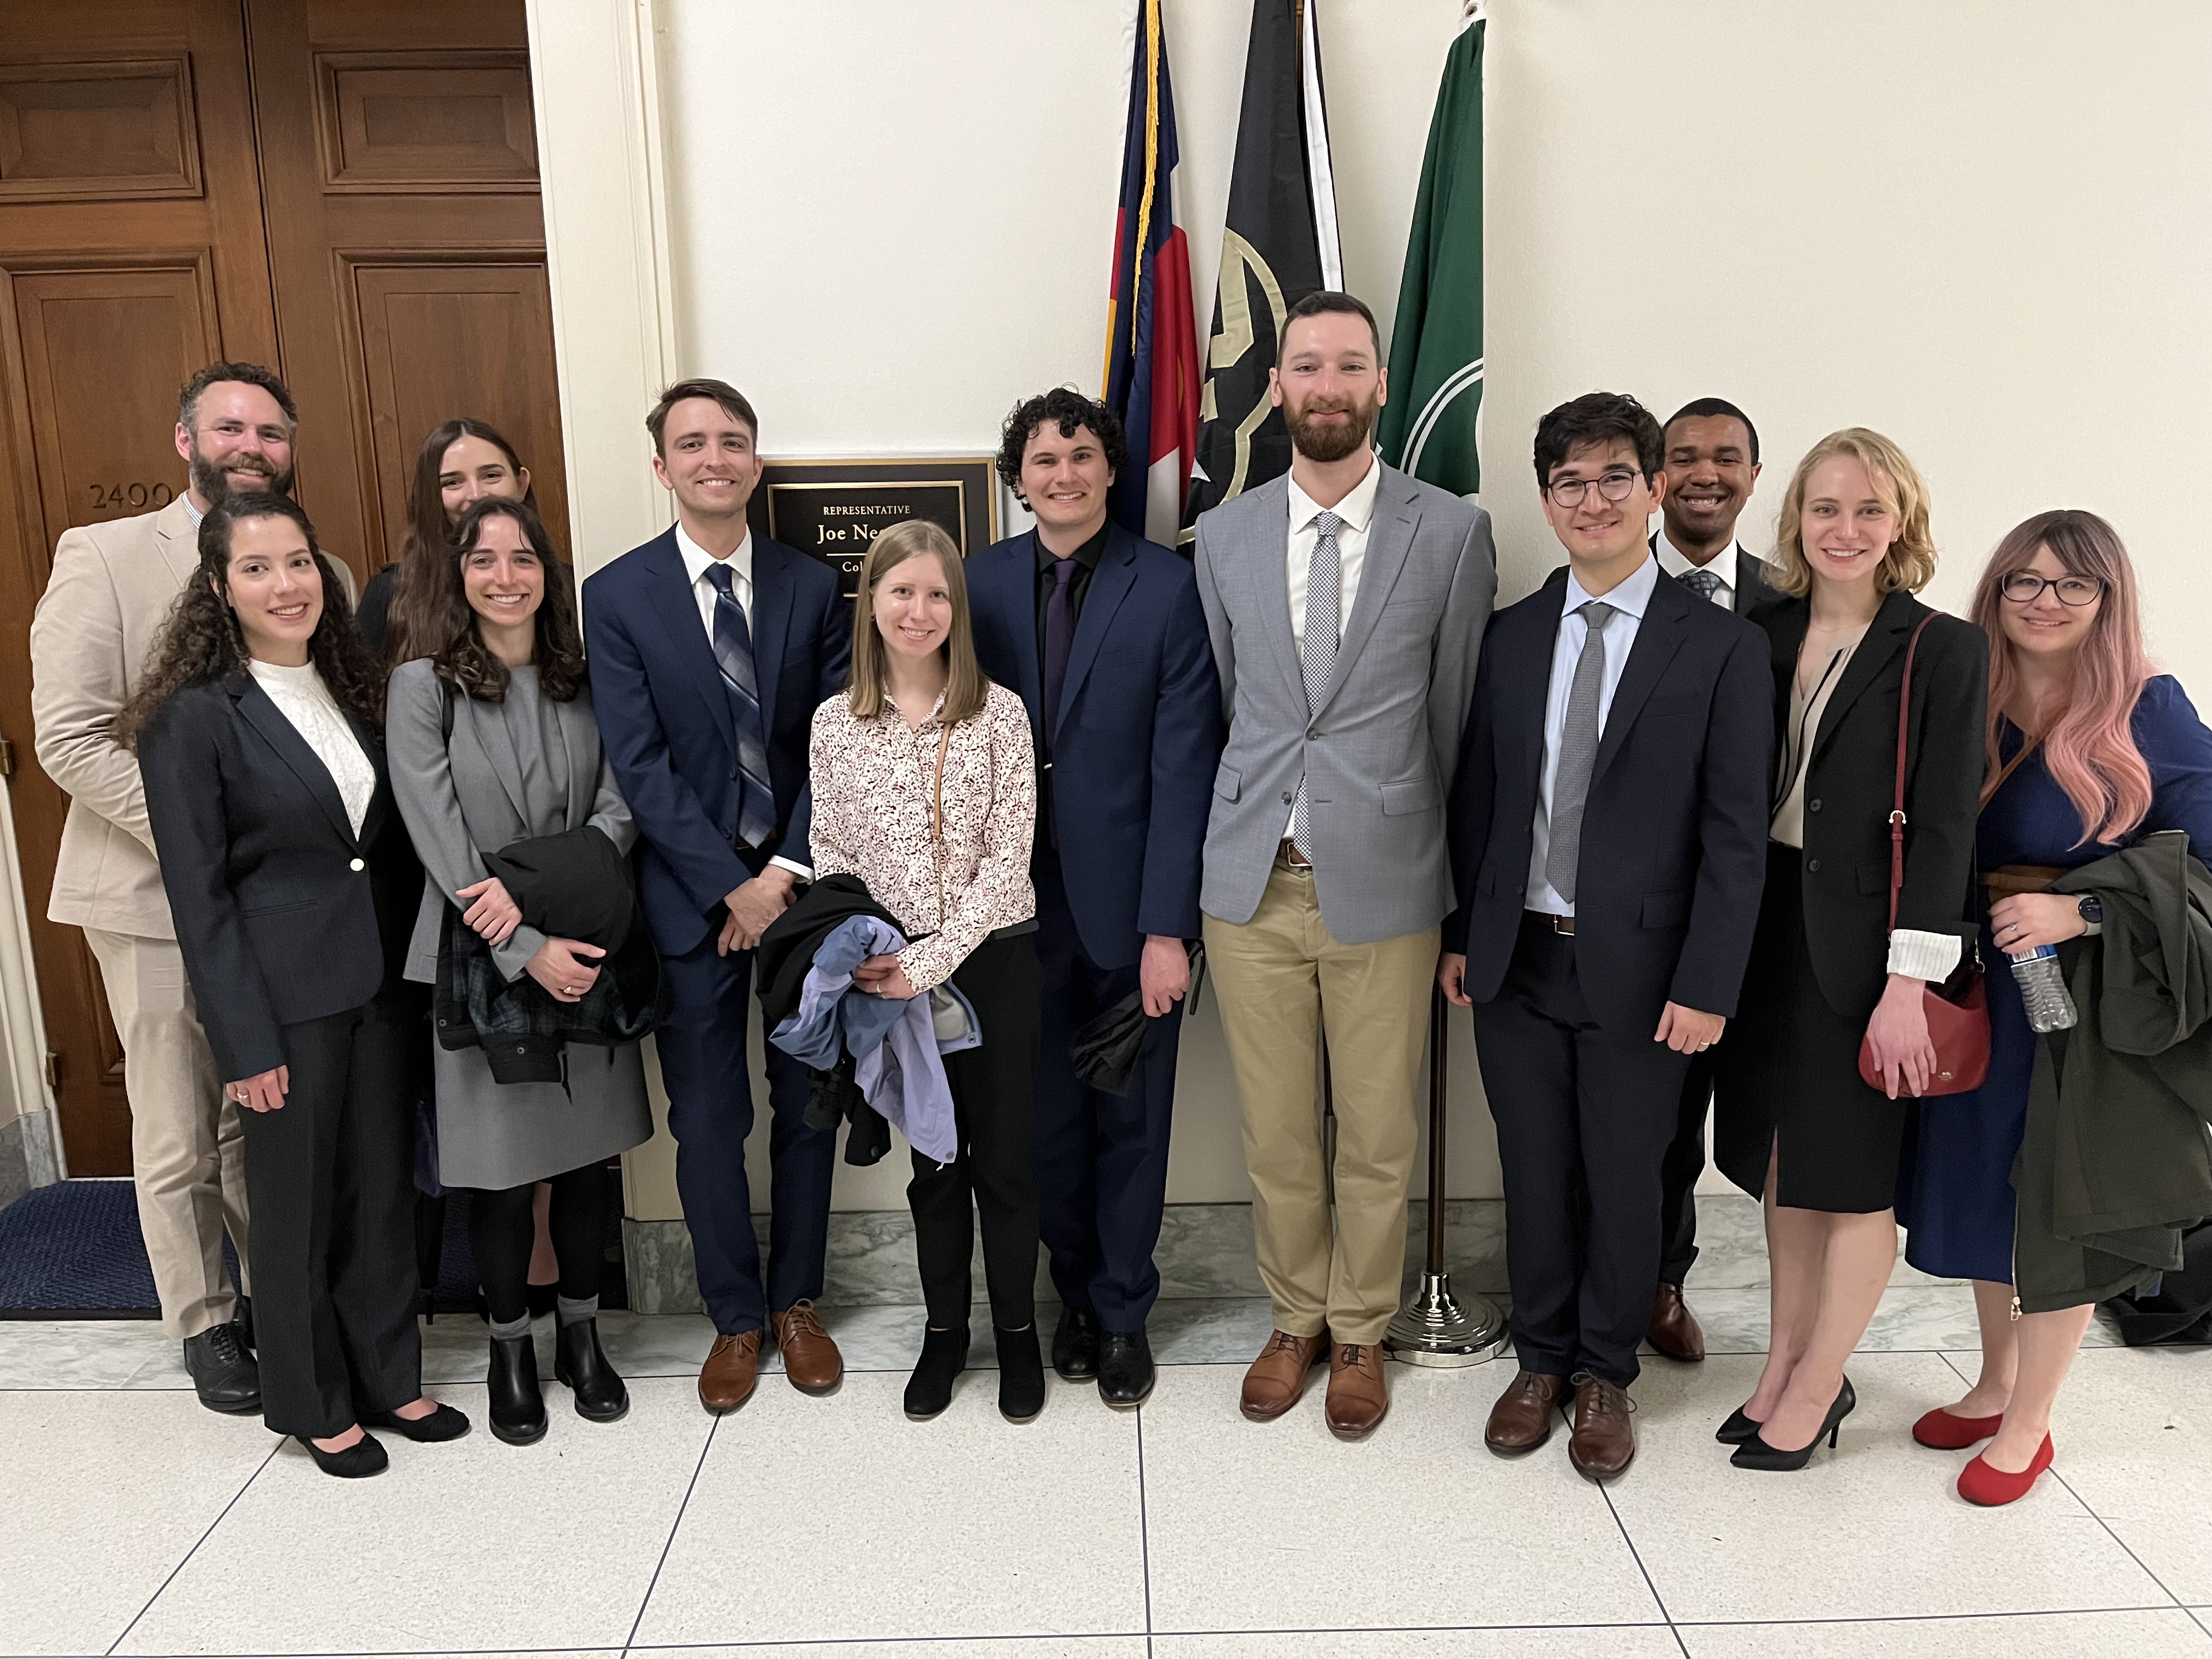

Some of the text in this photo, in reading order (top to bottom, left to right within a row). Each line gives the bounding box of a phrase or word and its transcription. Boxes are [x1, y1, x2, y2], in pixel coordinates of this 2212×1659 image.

[89, 482, 172, 509] 2400
[823, 505, 911, 516] REPRESENTATIVE
[817, 523, 881, 544] Joe Ne
[842, 561, 863, 572] Col
